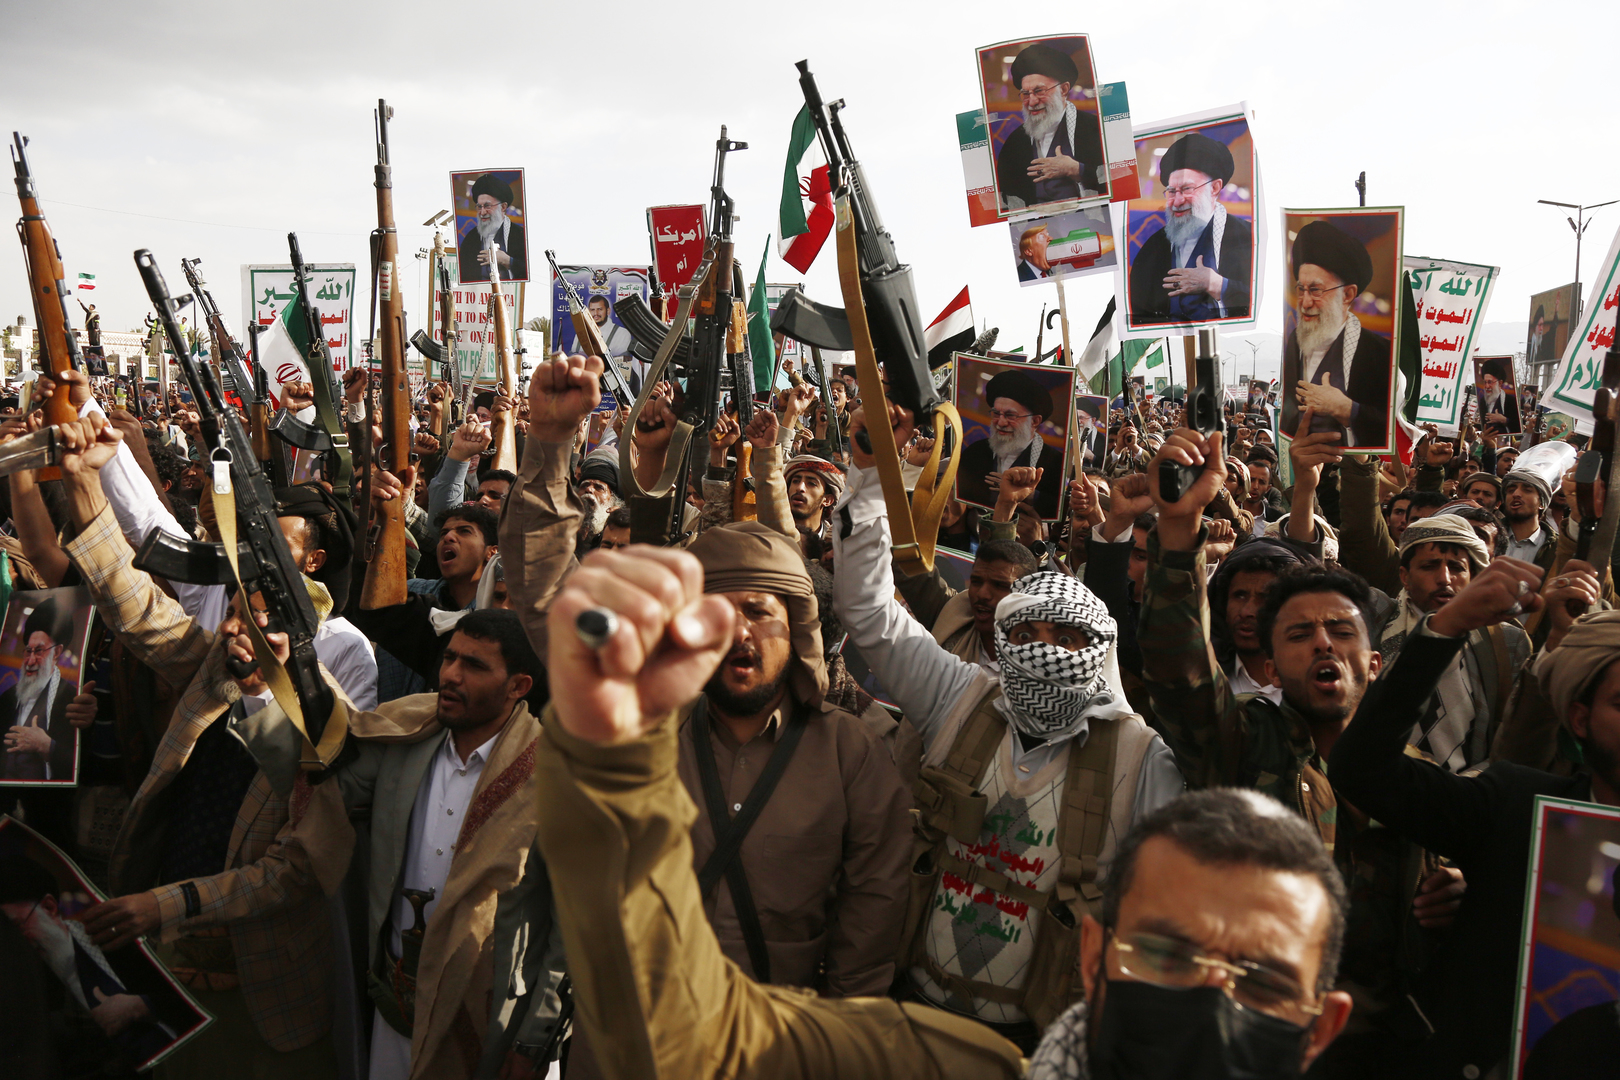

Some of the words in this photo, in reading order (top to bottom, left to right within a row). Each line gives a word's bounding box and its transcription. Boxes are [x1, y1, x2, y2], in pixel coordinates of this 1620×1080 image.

[656, 218, 702, 246] أمريكا
[676, 253, 688, 273] أم
[1411, 262, 1443, 292] أك
[1439, 270, 1485, 297] الله
[316, 277, 351, 300] الله
[465, 291, 476, 305] TO
[465, 311, 477, 324] TO
[1425, 306, 1473, 325] الموت
[1422, 358, 1458, 380] اللعنة
[1418, 383, 1452, 410] النص
